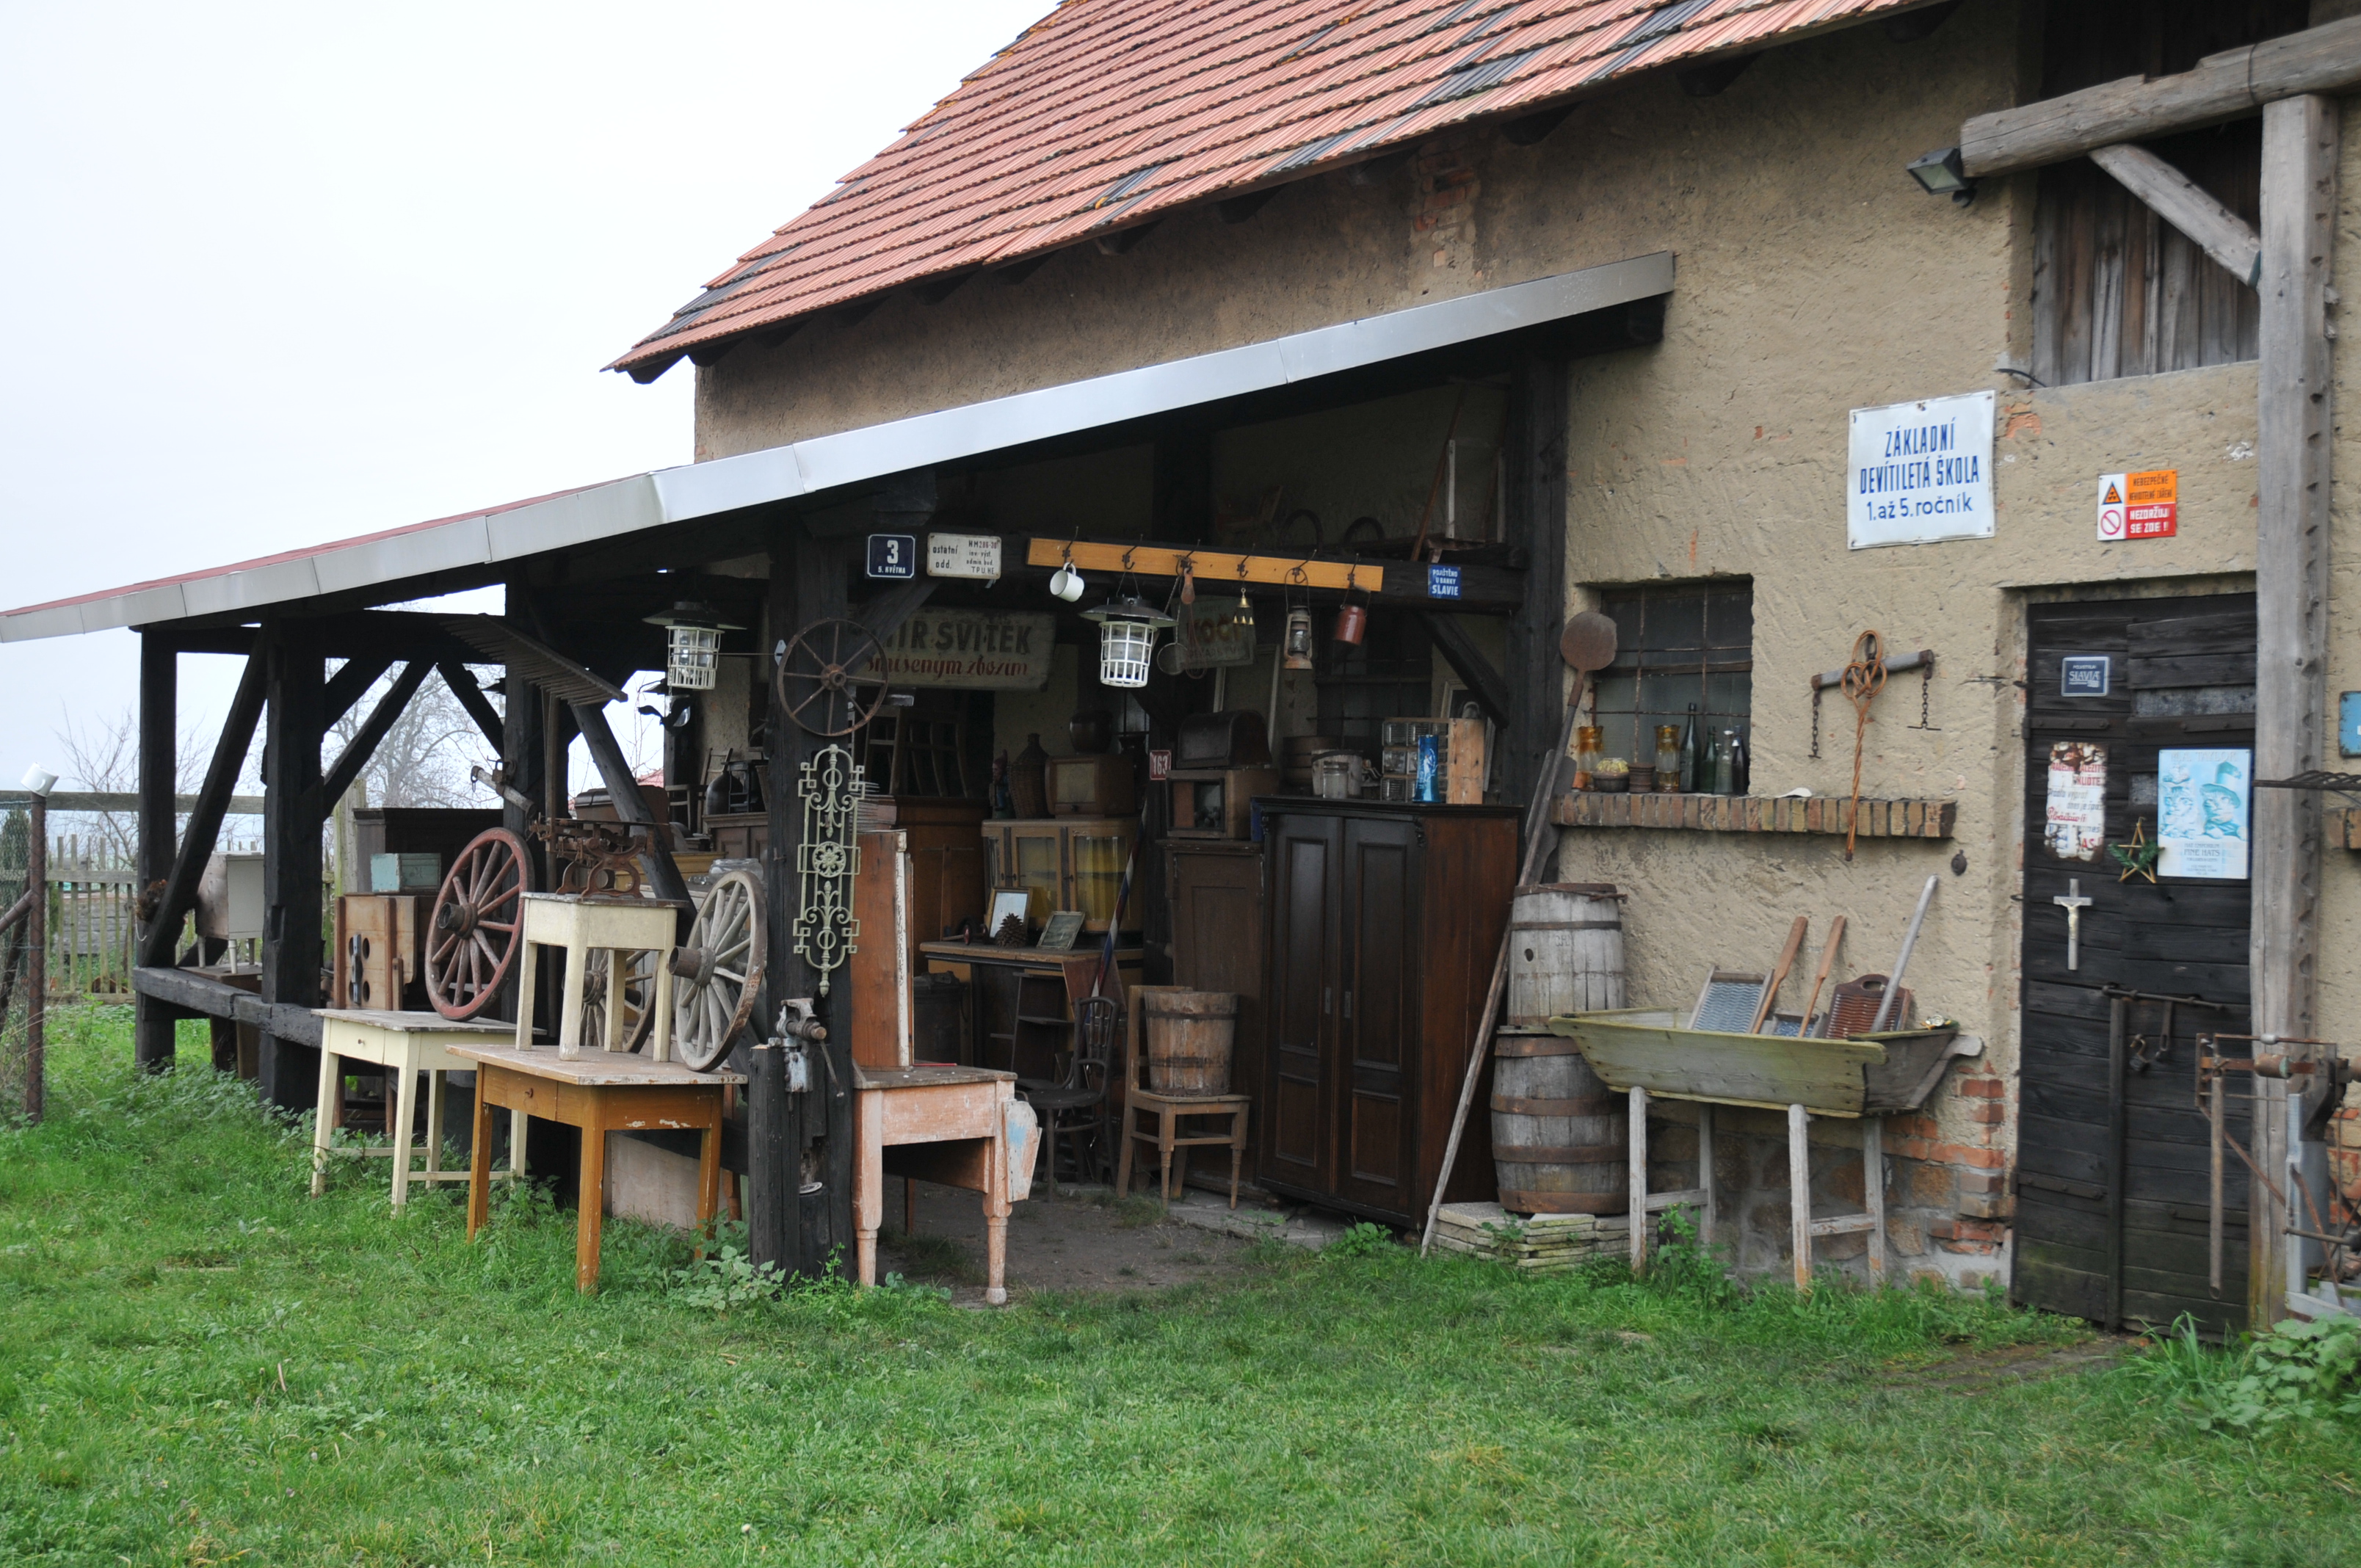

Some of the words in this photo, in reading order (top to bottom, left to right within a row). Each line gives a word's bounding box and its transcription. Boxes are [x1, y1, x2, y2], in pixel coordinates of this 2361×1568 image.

[1885, 416, 1956, 458] ZÁKLADNÍ
[1860, 456, 1931, 495] DEVÍTILETÁ
[1936, 454, 1980, 487] ŠKOLA
[1915, 492, 1973, 516] ročník
[2130, 506, 2169, 520] NEZDRŽUJ
[2130, 523, 2143, 534] SE
[2144, 521, 2161, 534] ZDE
[887, 540, 899, 564] 3
[932, 545, 958, 555] ostatní
[877, 565, 884, 573] 5.
[885, 565, 906, 574] KVĚTNA
[935, 559, 951, 569] odd.
[1440, 577, 1456, 585] BANKY
[1432, 584, 1459, 596] SLAVIE
[1153, 755, 1167, 775] 163
[2184, 849, 2199, 857] FINE
[2201, 849, 2221, 857] HATS
